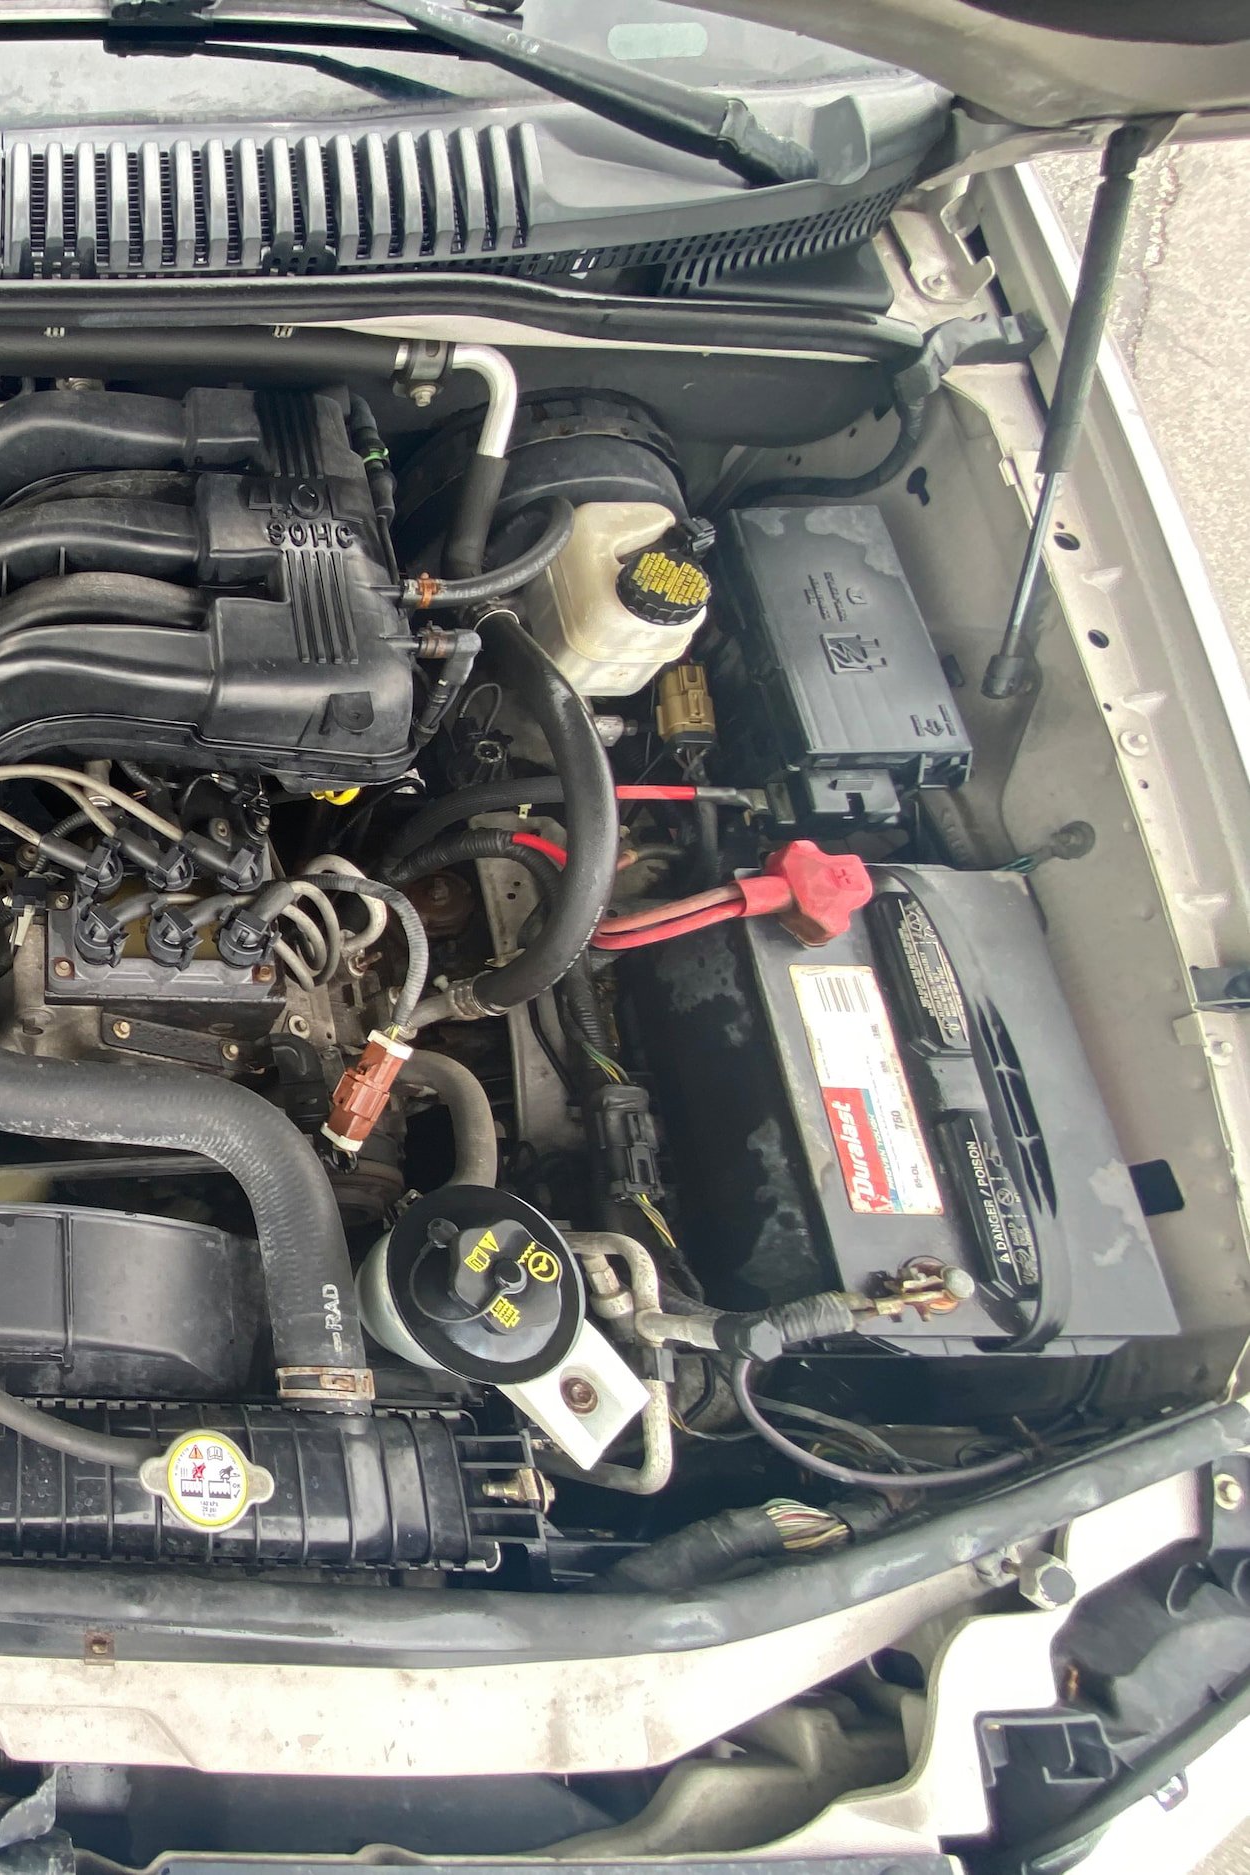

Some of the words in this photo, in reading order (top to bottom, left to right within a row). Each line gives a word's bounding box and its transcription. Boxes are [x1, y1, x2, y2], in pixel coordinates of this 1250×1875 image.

[267, 522, 354, 549] SOHC
[831, 1100, 876, 1199] Duralast
[966, 1141, 989, 1187] POISON
[983, 1199, 1008, 1251] DANGER
